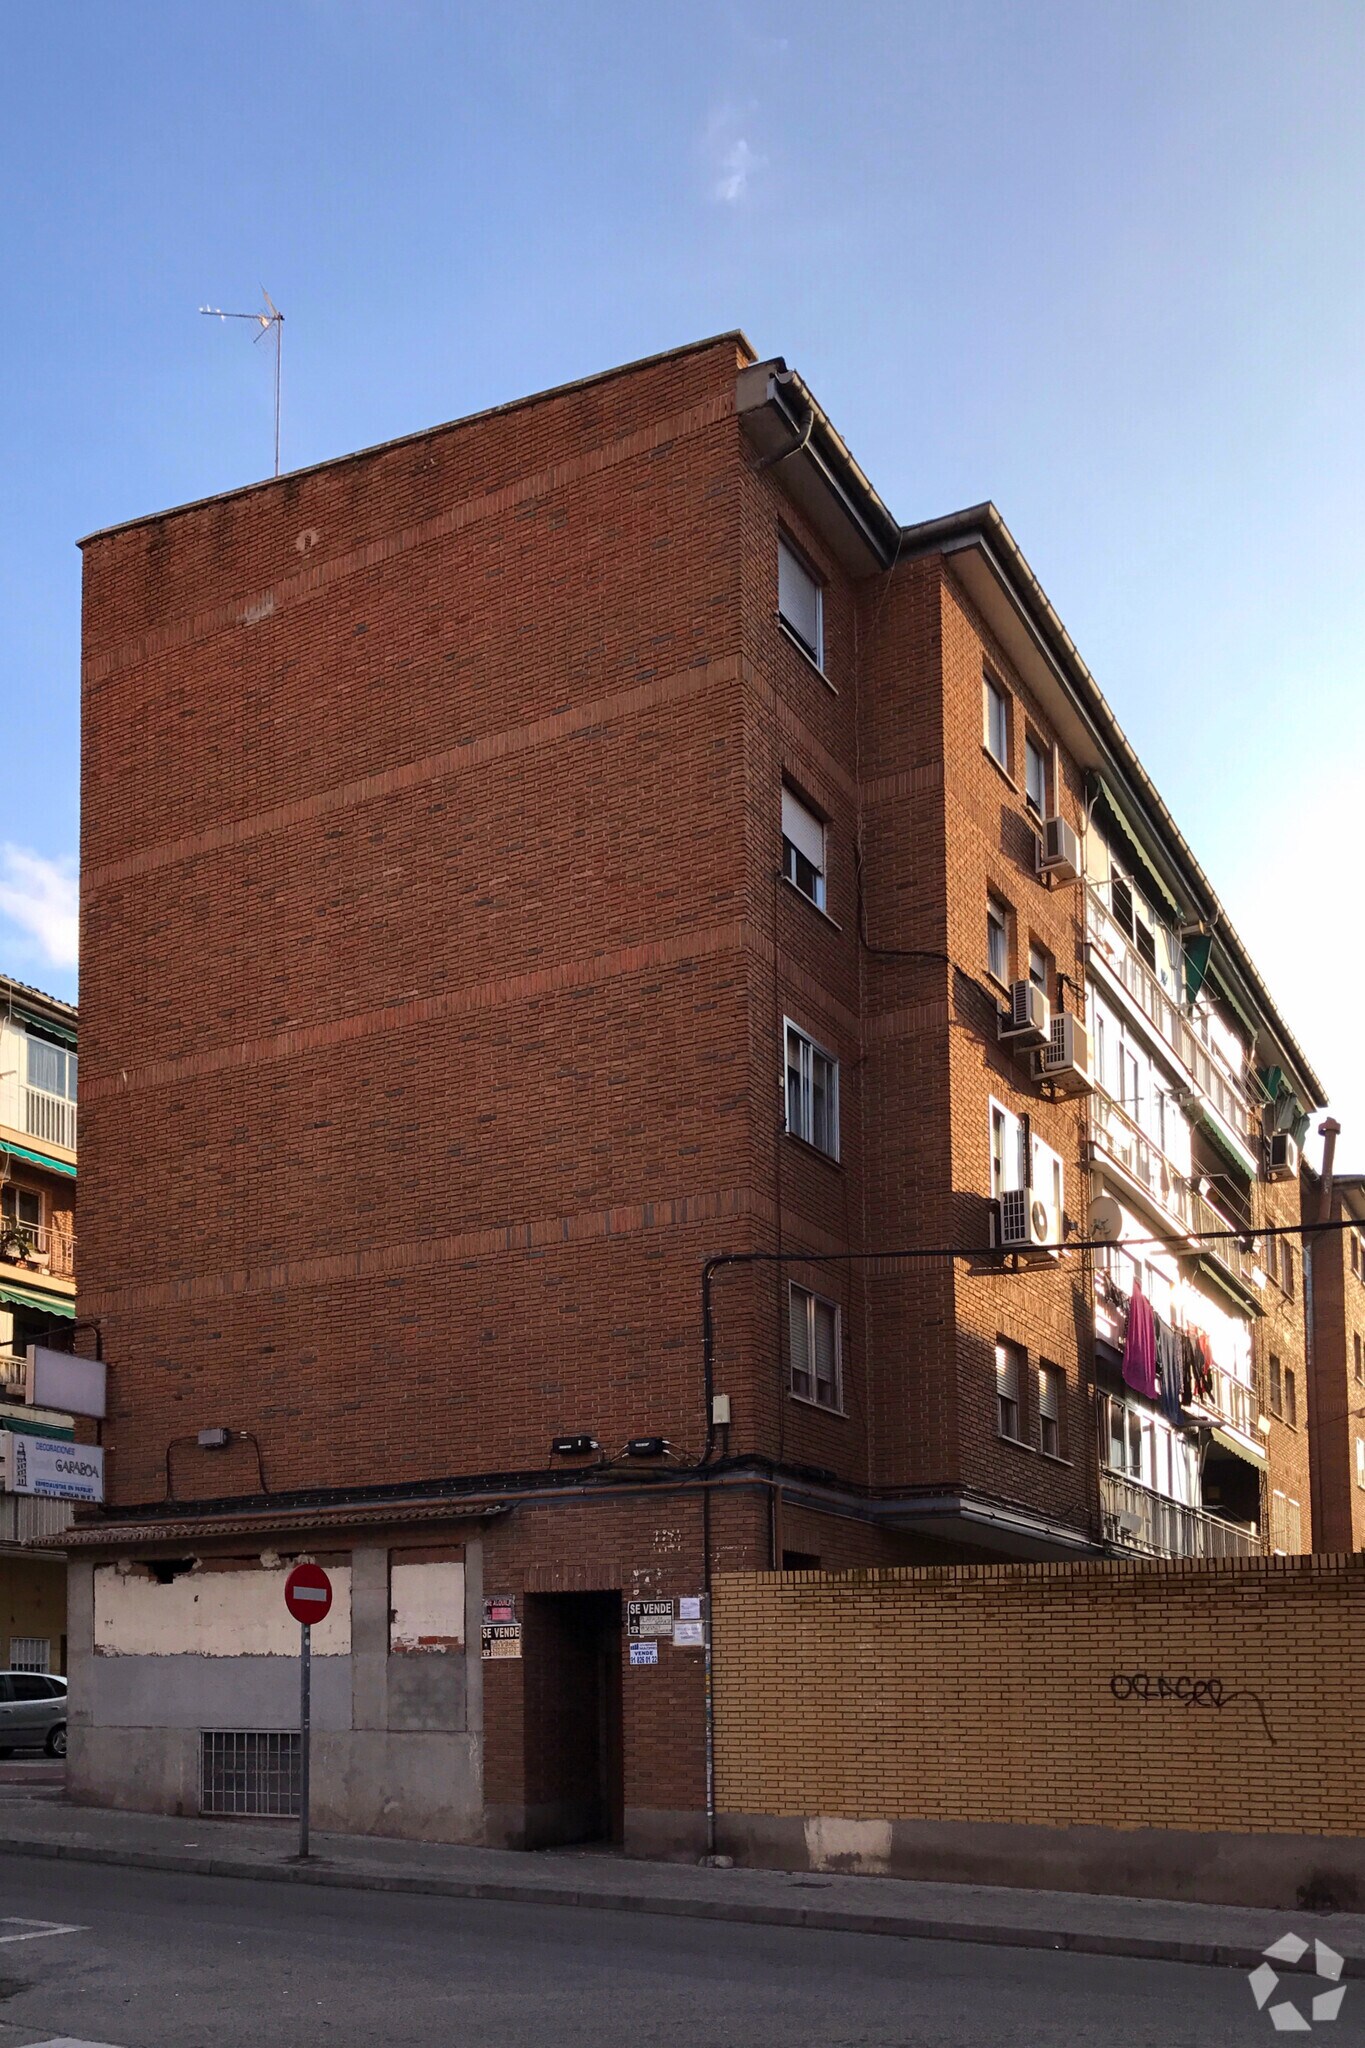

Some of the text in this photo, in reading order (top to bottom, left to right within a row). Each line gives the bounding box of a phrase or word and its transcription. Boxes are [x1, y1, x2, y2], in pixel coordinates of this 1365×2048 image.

[630, 1603, 641, 1615] SE
[643, 1602, 672, 1615] VENDE
[482, 1626, 520, 1639] SE VENDE
